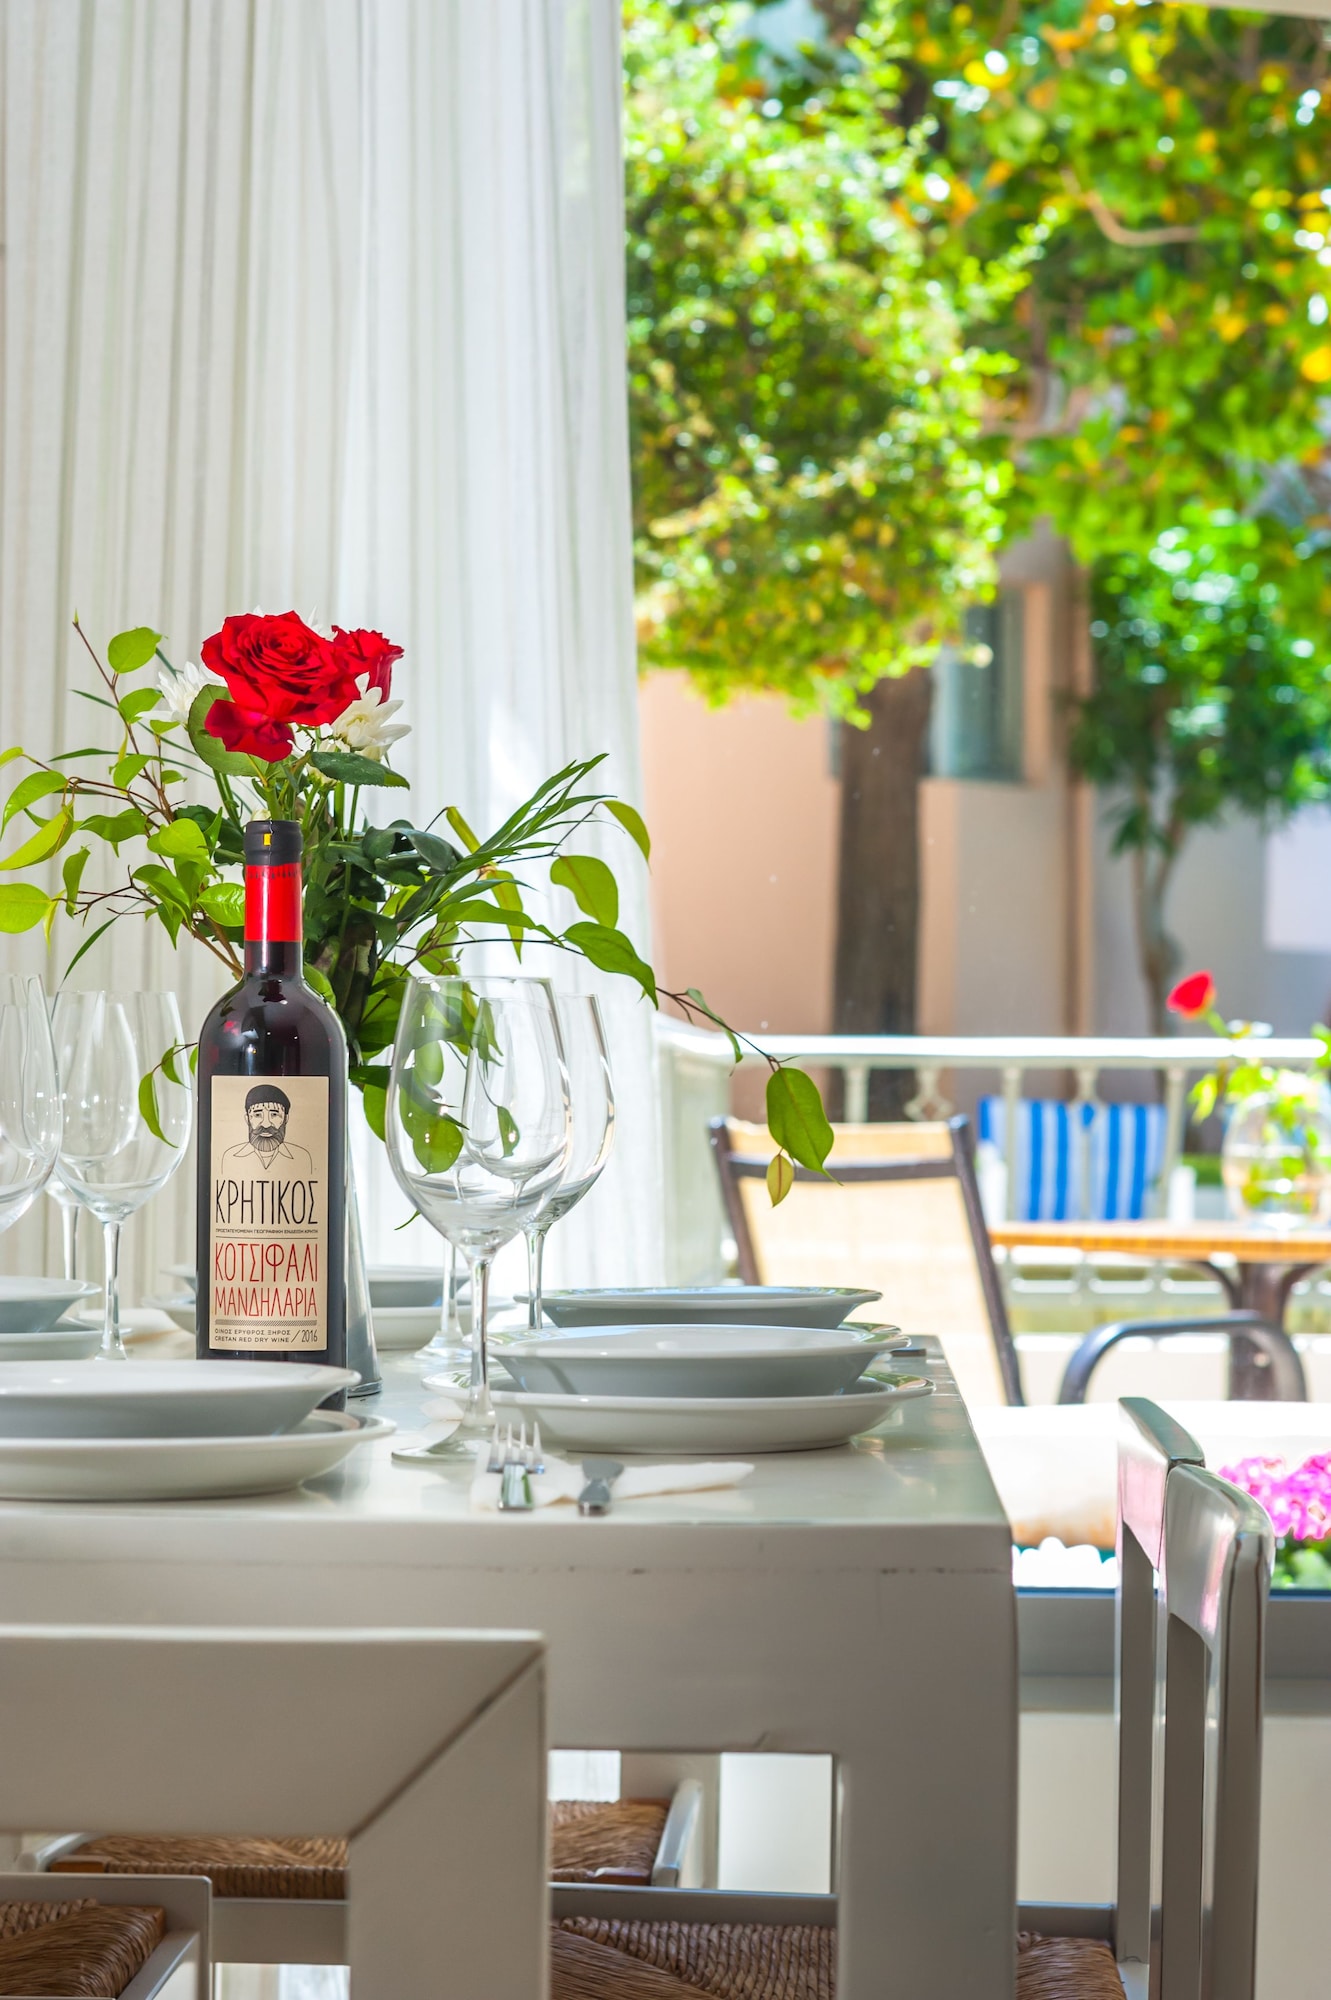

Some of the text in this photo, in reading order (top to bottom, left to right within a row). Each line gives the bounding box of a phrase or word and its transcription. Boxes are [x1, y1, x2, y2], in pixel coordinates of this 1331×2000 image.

[215, 1179, 318, 1225] ΚΡΗΤΙΚΟΣ
[215, 1242, 318, 1283] ΚΟΤΣΙΦΑΛΙ
[214, 1286, 318, 1317] ΜΑΝΔΗΛΑΡΙΑ
